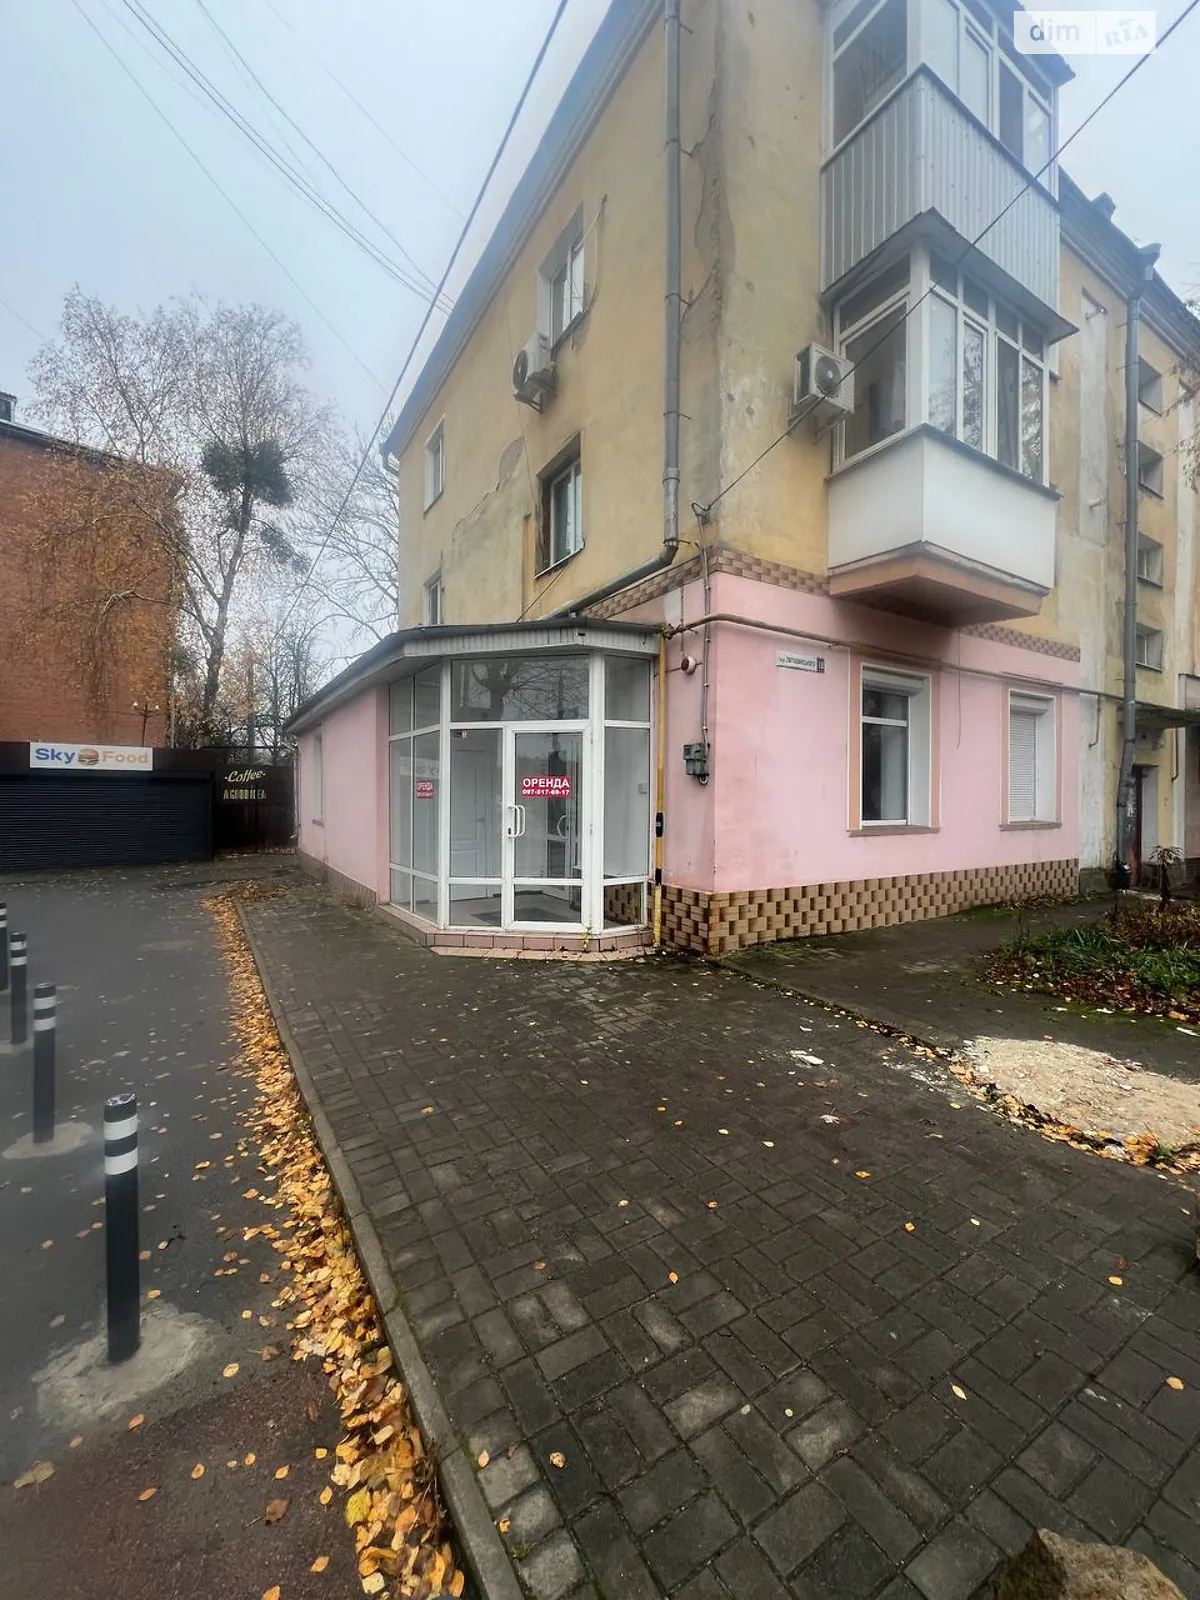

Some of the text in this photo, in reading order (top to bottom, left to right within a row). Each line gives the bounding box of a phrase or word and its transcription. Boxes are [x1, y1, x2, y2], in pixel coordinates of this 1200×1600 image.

[35, 748, 149, 764] Sky Food
[227, 769, 263, 782] Coffee
[522, 778, 570, 789] ОРЕНДА
